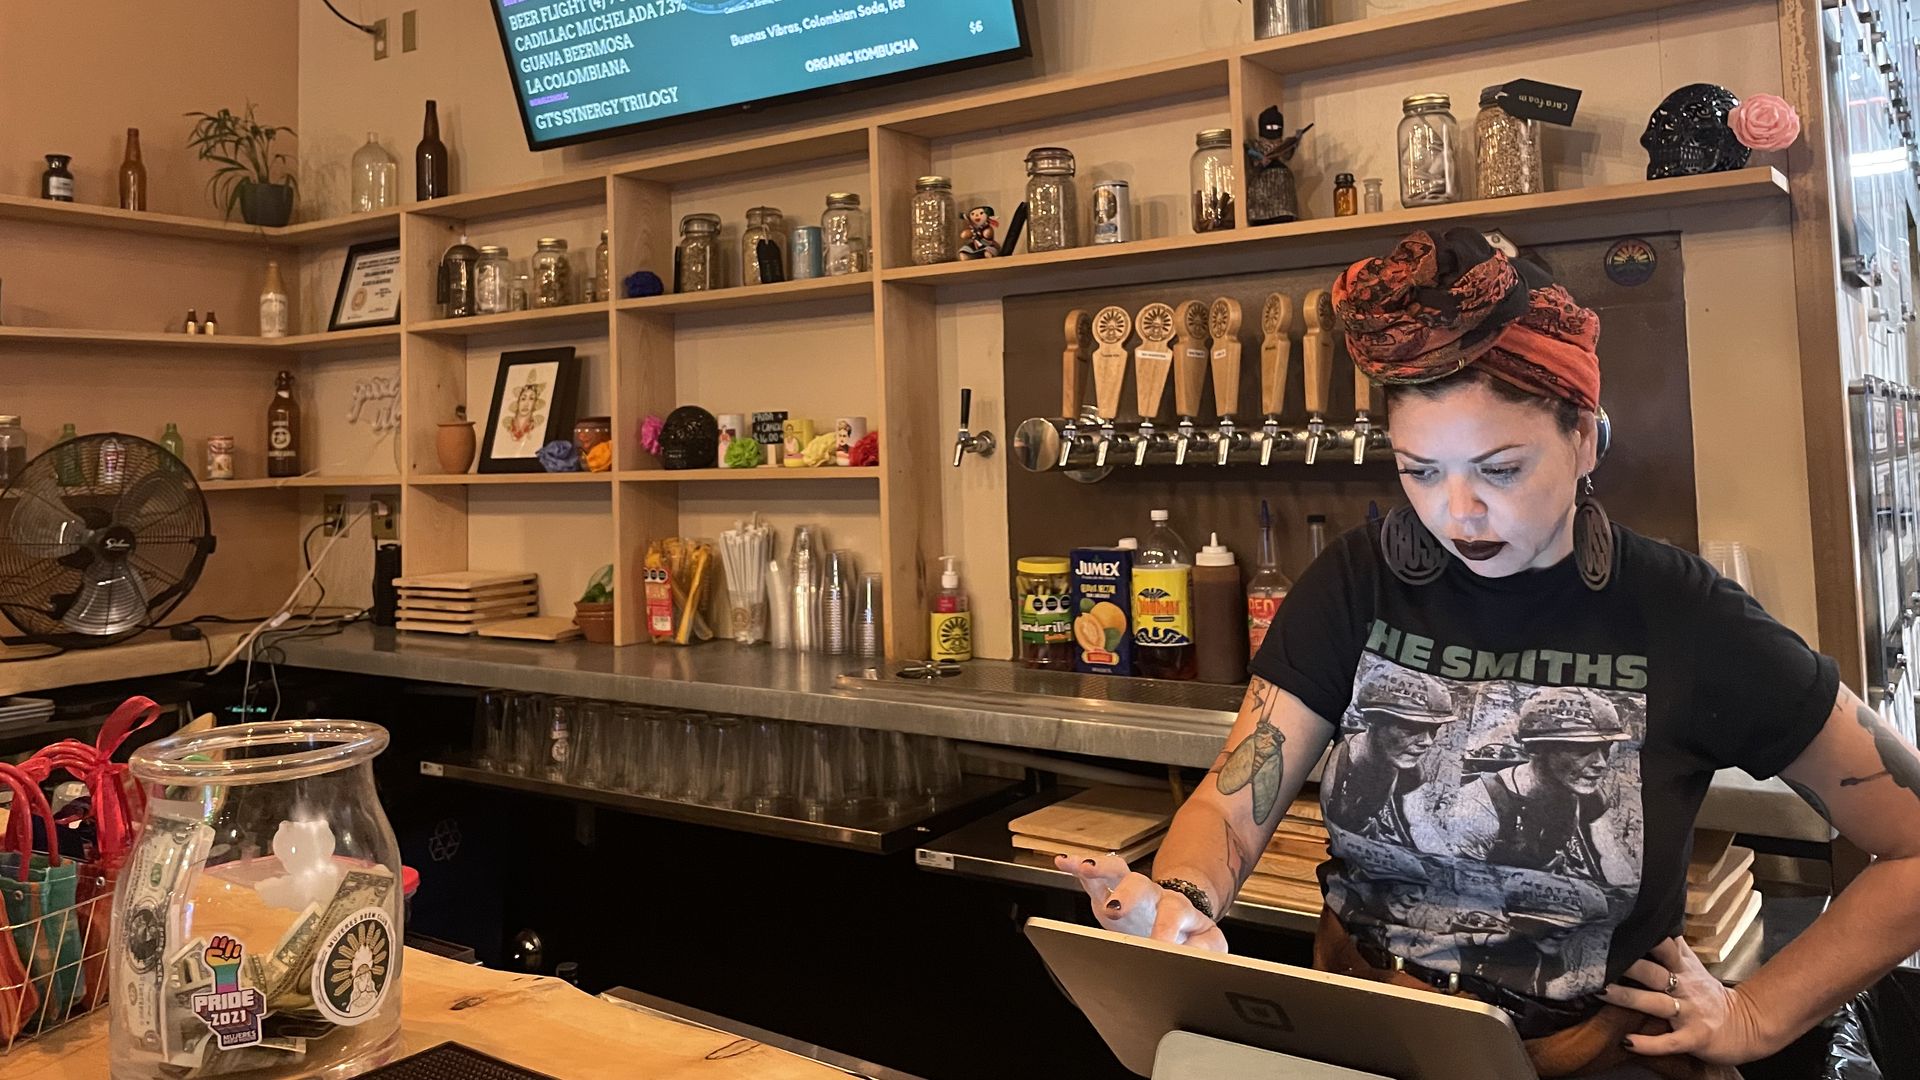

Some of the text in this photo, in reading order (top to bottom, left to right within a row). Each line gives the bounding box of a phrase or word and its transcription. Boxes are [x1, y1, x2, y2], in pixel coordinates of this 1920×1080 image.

[508, 10, 540, 31] BEER
[539, 0, 586, 23] FLIGHT
[514, 25, 577, 52] CADILLAC
[575, 3, 659, 38] MICHELADA
[729, 29, 767, 47] Buenas
[766, 22, 803, 38] Vibras,
[802, 9, 858, 30] Colombian
[857, 4, 889, 20] Soda,
[968, 19, 984, 35] $6
[520, 33, 635, 74] GUAVA BEERMOSA
[804, 38, 919, 74] ORGANIC KOMBUCHA
[525, 57, 631, 95] LA COLOMBIANA
[562, 97, 621, 126] SYNERGY
[619, 86, 679, 113] TRILOGY
[1074, 560, 1121, 577] JUMEX
[1366, 619, 1648, 689] HE SMITHS
[1537, 699, 1575, 709] MEAT
[1537, 708, 1591, 719] MURDER
[327, 917, 358, 949] MUJERES
[194, 989, 254, 1013] PRIDE
[210, 1009, 247, 1026] 2021
